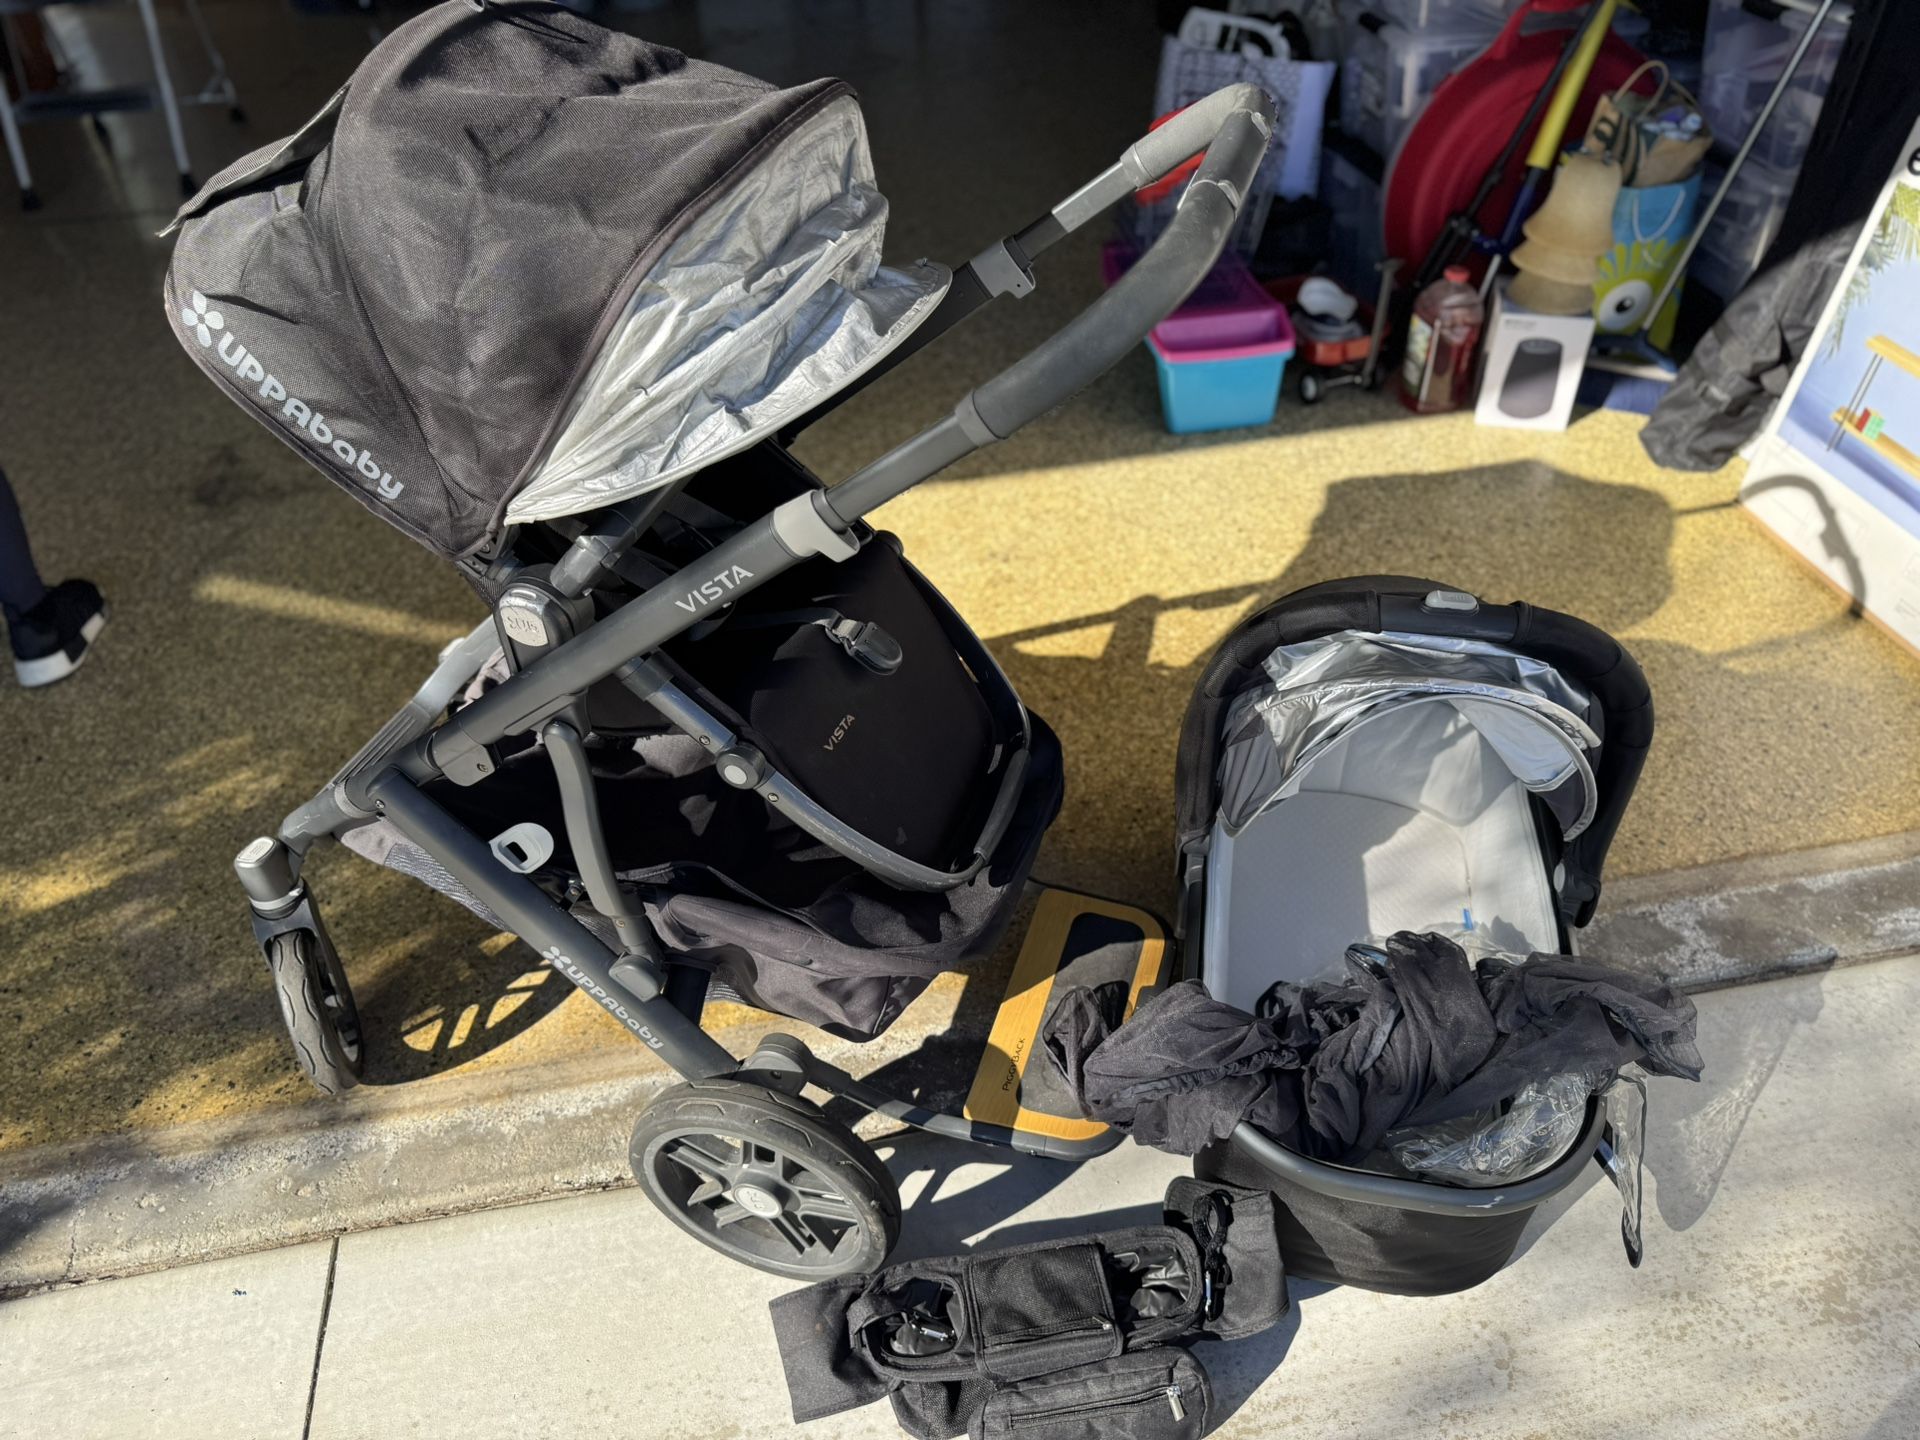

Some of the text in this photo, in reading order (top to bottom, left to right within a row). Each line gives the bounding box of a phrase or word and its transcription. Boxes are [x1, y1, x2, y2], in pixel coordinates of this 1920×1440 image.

[217, 331, 404, 500] UPPAbaby
[674, 564, 755, 614] VISTA
[823, 713, 856, 751] VISTA
[566, 964, 665, 1049] UPPAbaby
